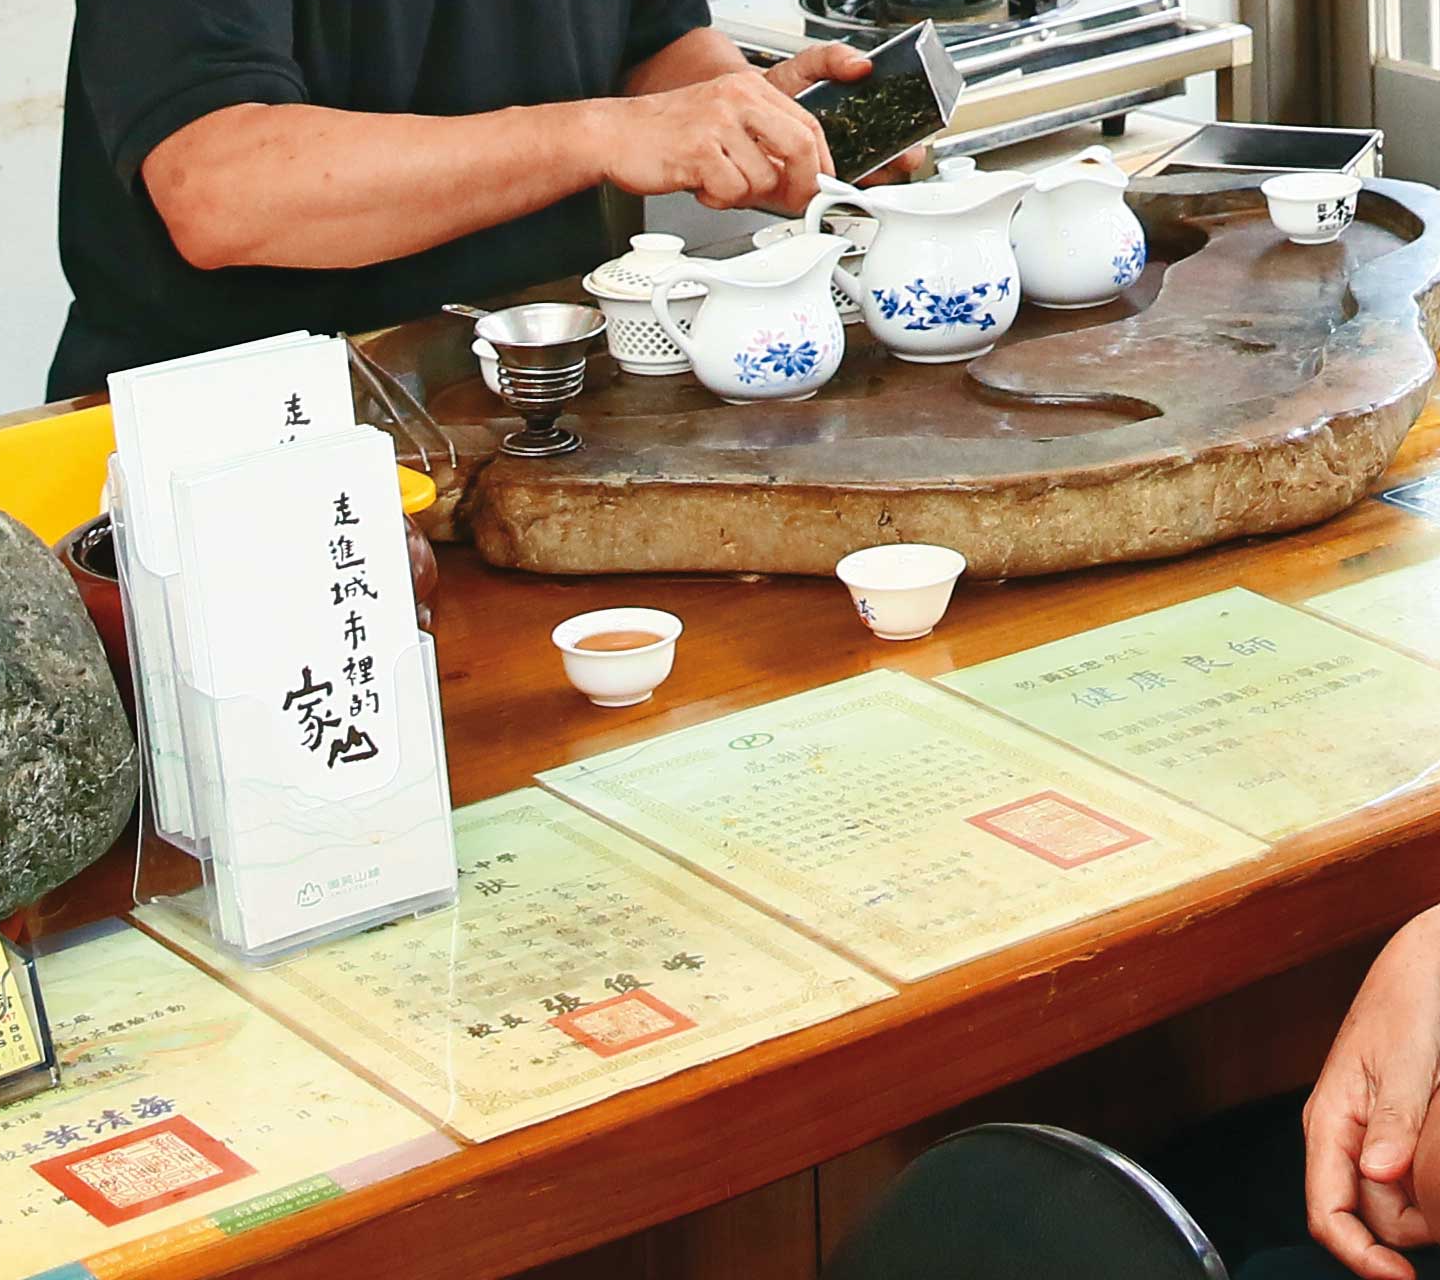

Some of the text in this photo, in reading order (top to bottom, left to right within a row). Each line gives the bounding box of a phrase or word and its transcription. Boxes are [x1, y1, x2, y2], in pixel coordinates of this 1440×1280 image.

[328, 491, 380, 717] 走進城市裡的
[1071, 635, 1281, 711] 健康良師
